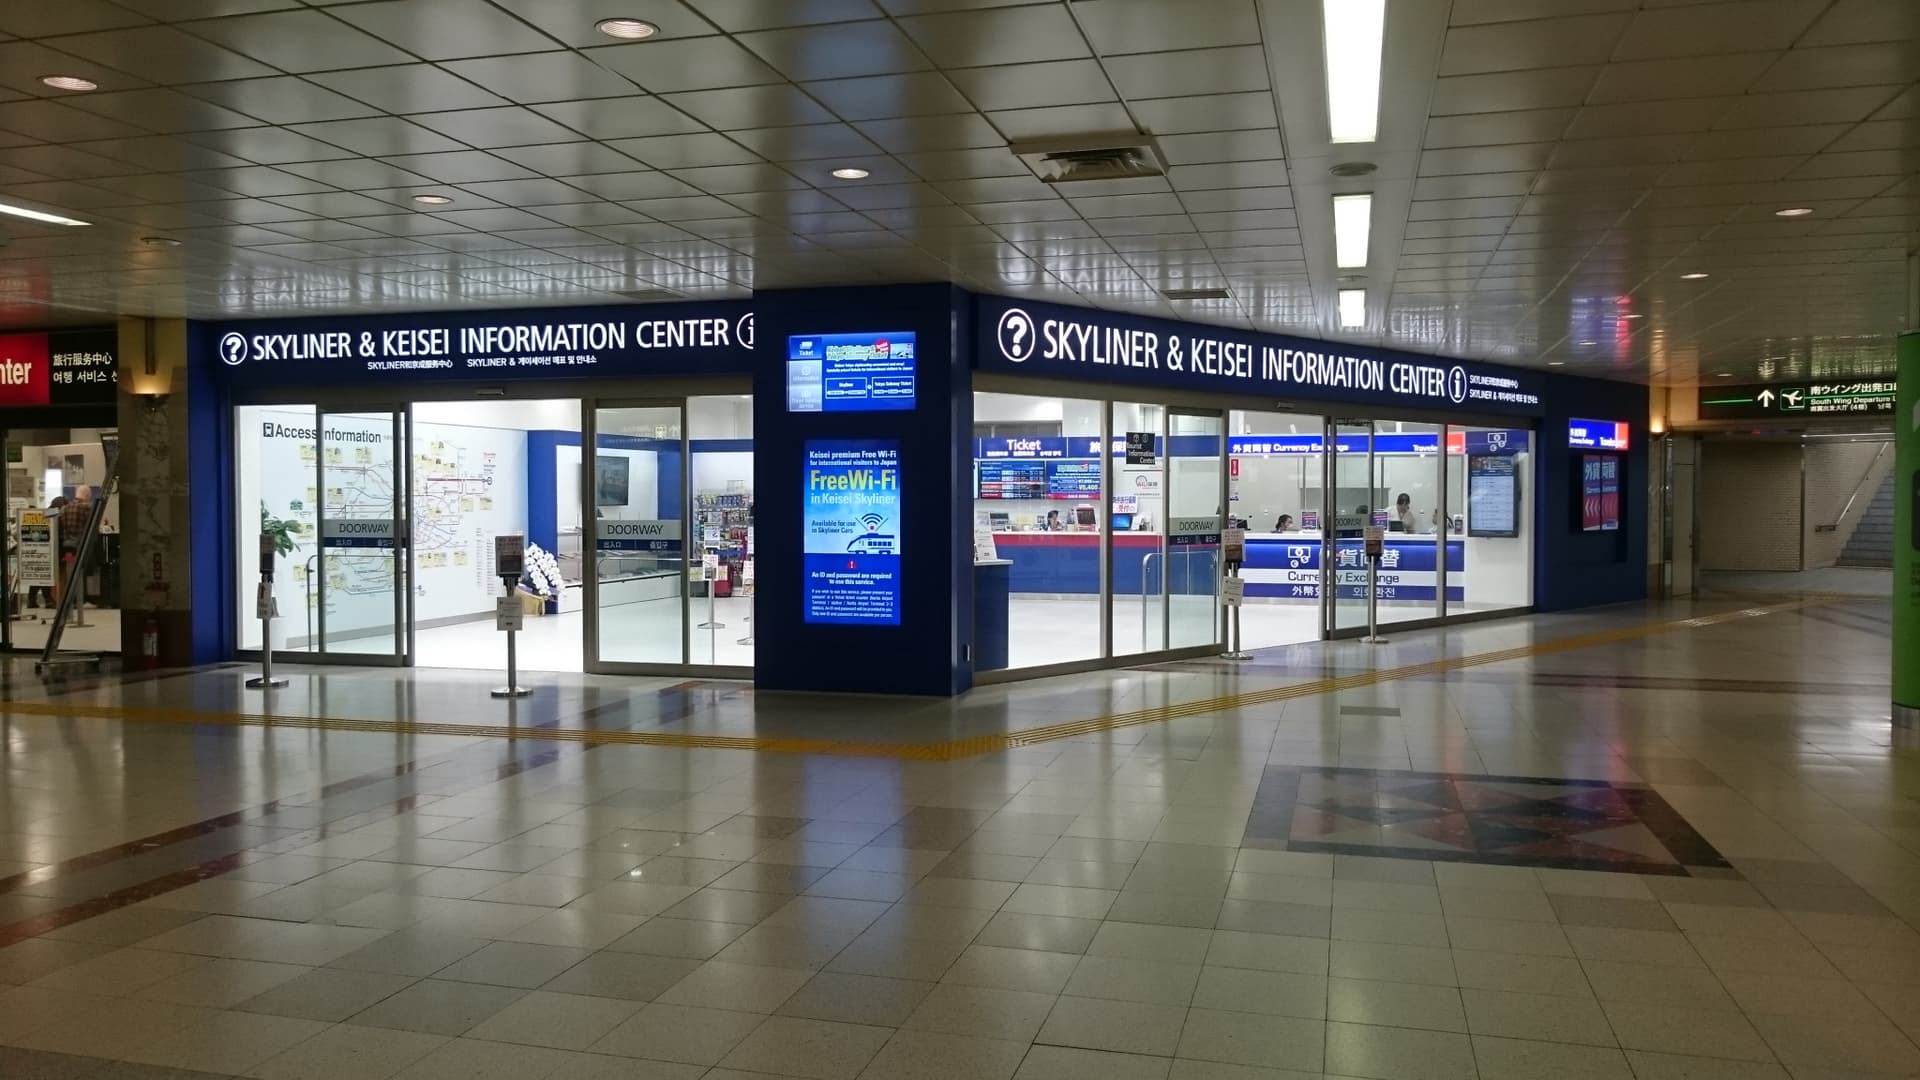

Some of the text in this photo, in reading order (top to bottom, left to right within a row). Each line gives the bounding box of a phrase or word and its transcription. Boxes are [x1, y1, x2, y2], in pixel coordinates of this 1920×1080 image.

[253, 318, 730, 361] SKYLINER & KEISEI INFORMATION CENTER
[53, 352, 113, 367] 旅行服务中心
[467, 357, 507, 368] SKYLINER
[1043, 319, 1445, 397] SKYLINER & KEISEI INFORMATION CENTER
[77, 369, 107, 383] 서비스
[1853, 396, 1891, 404] Departure
[275, 424, 382, 443] Access nformation
[1006, 438, 1042, 451] Ticket
[809, 450, 897, 460] Keisei premium Free Wi-Fi
[811, 492, 896, 506] in Keisei Skyliner
[339, 523, 390, 534] DOORWAY
[607, 524, 664, 535] DOORWAY
[1179, 520, 1214, 531] DOORWAY
